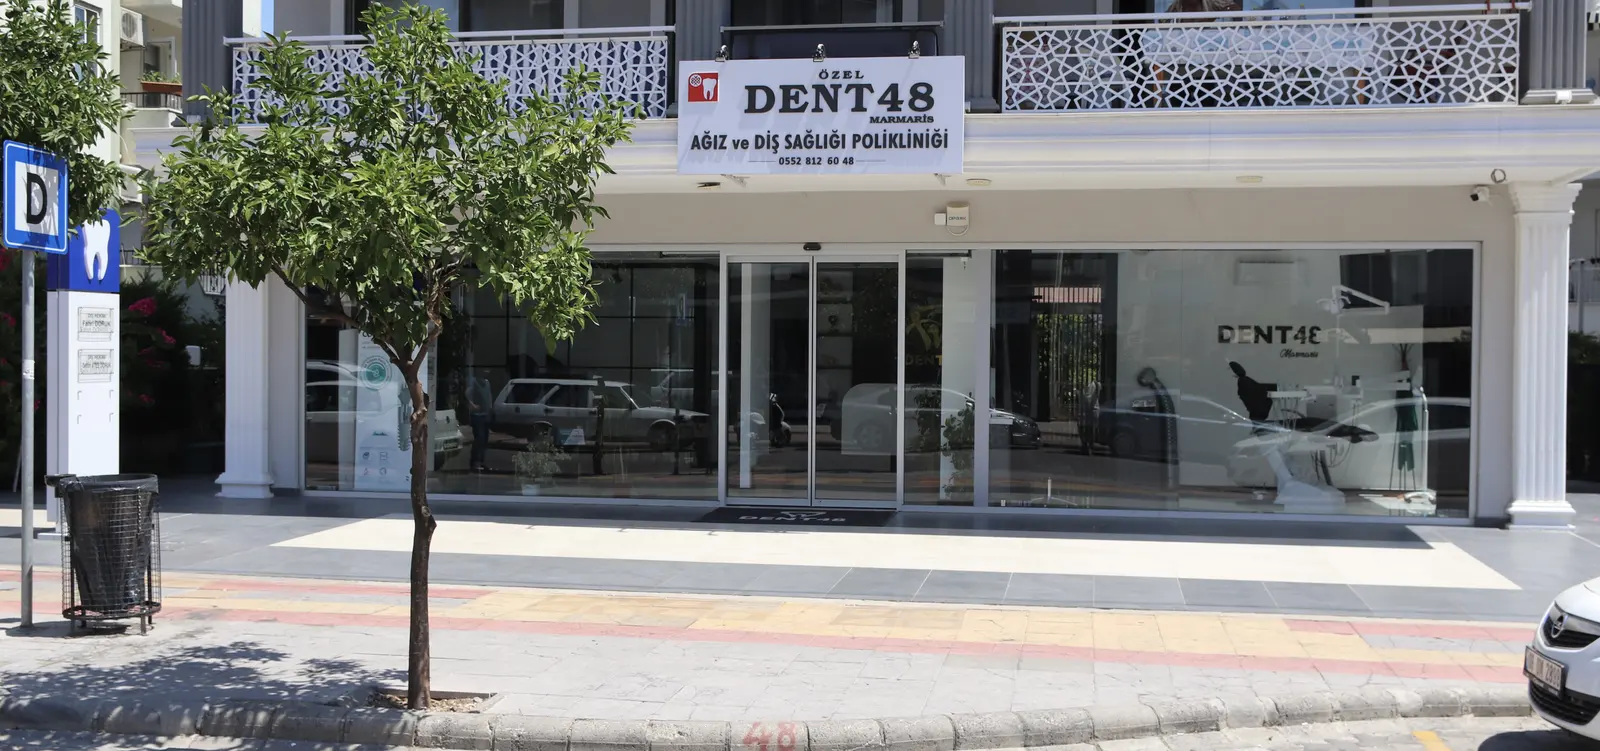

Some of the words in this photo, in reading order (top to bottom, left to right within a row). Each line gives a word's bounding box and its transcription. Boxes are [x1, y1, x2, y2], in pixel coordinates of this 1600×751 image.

[818, 69, 864, 80] ÖZEL
[744, 82, 935, 114] DENT48
[869, 113, 935, 124] MARMARİS
[690, 130, 728, 151] AĞIZ
[732, 138, 750, 150] ve
[754, 130, 779, 154] DİŞ
[784, 129, 846, 150] SAĞLIĞI
[852, 128, 949, 150] POLİKLİNİĞİ
[778, 157, 802, 166] 0552
[805, 157, 822, 166] 812
[827, 157, 840, 166] 60
[842, 157, 855, 166] 48
[26, 171, 48, 225] D
[743, 721, 796, 751] 48
